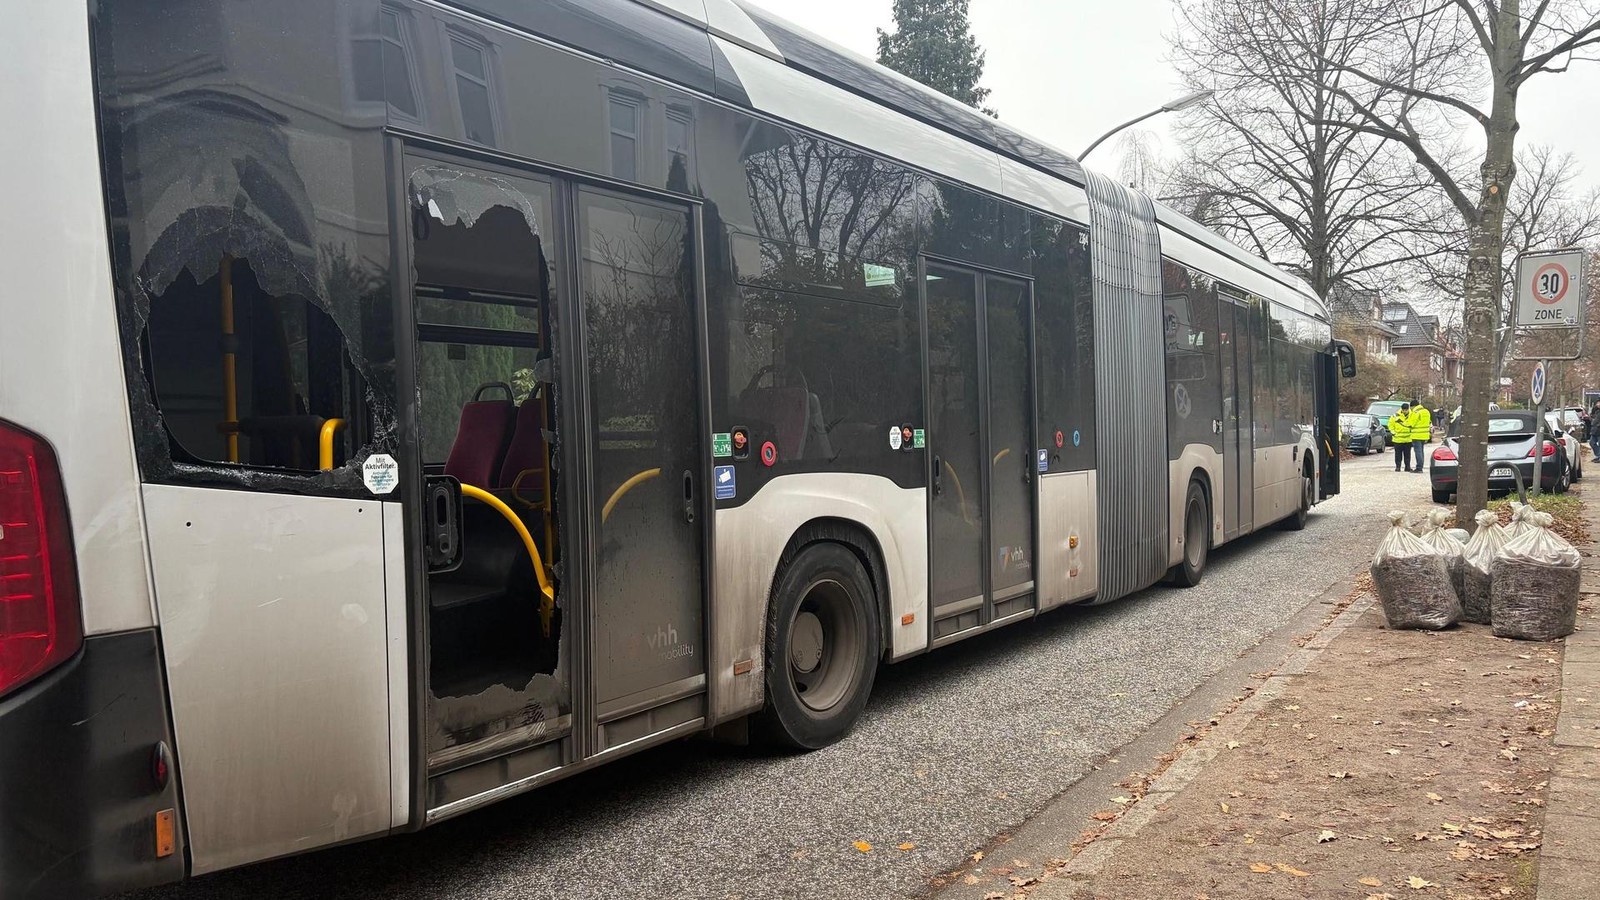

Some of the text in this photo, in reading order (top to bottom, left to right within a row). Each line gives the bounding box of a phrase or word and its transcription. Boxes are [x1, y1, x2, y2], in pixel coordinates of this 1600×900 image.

[1540, 273, 1559, 294] 30
[1535, 309, 1562, 320] ZONE
[647, 623, 678, 649] vhh
